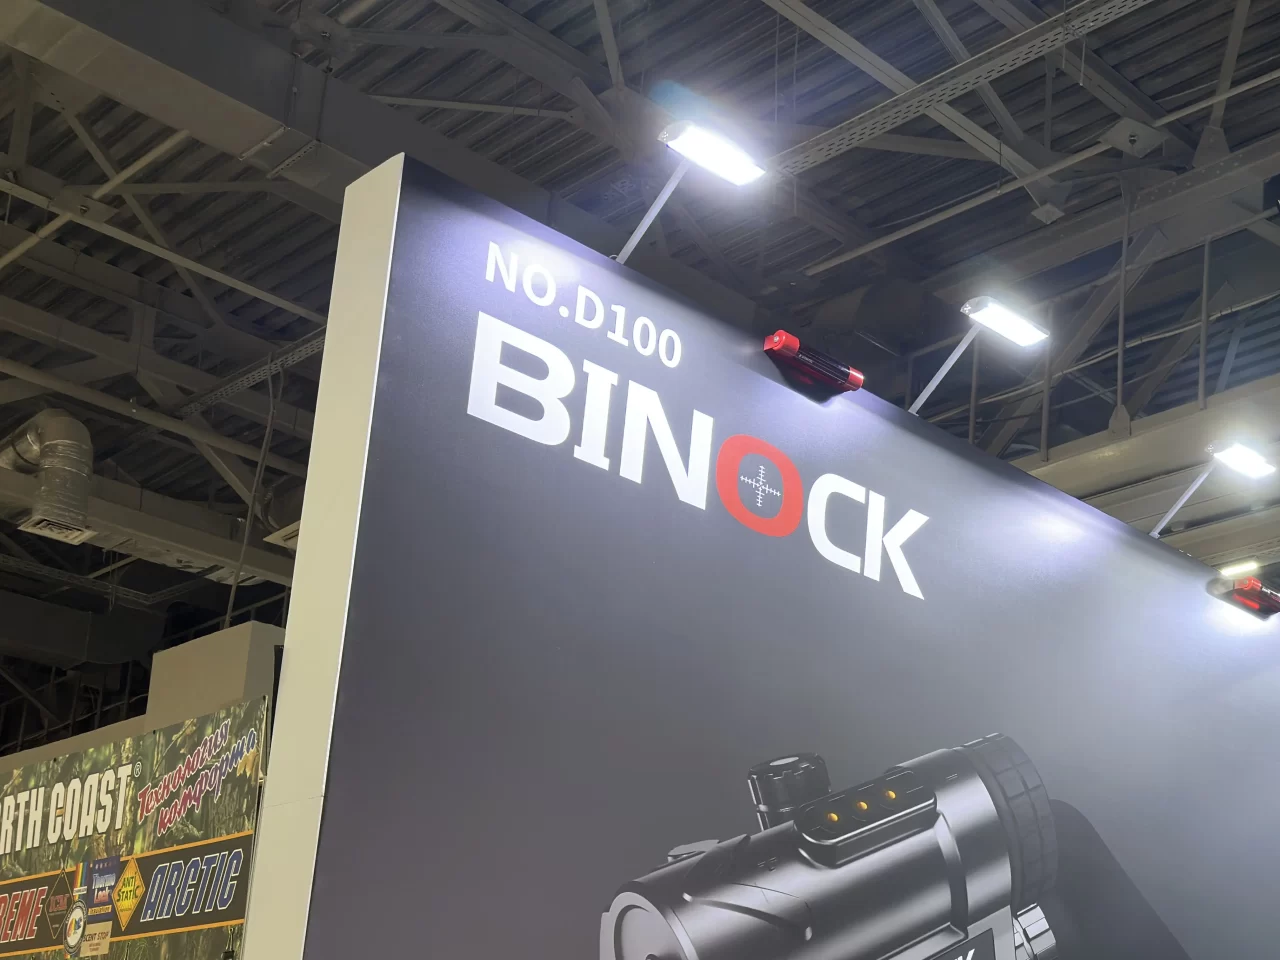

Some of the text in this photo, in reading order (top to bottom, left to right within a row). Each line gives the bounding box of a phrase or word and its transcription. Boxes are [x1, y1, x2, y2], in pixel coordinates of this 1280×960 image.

[485, 241, 682, 368] NO.D100
[467, 311, 930, 600] BINOCK
[47, 764, 132, 844] COAST
[138, 719, 231, 825] Технология
[116, 886, 139, 902] STATIC
[140, 848, 243, 923] ARCTIC
